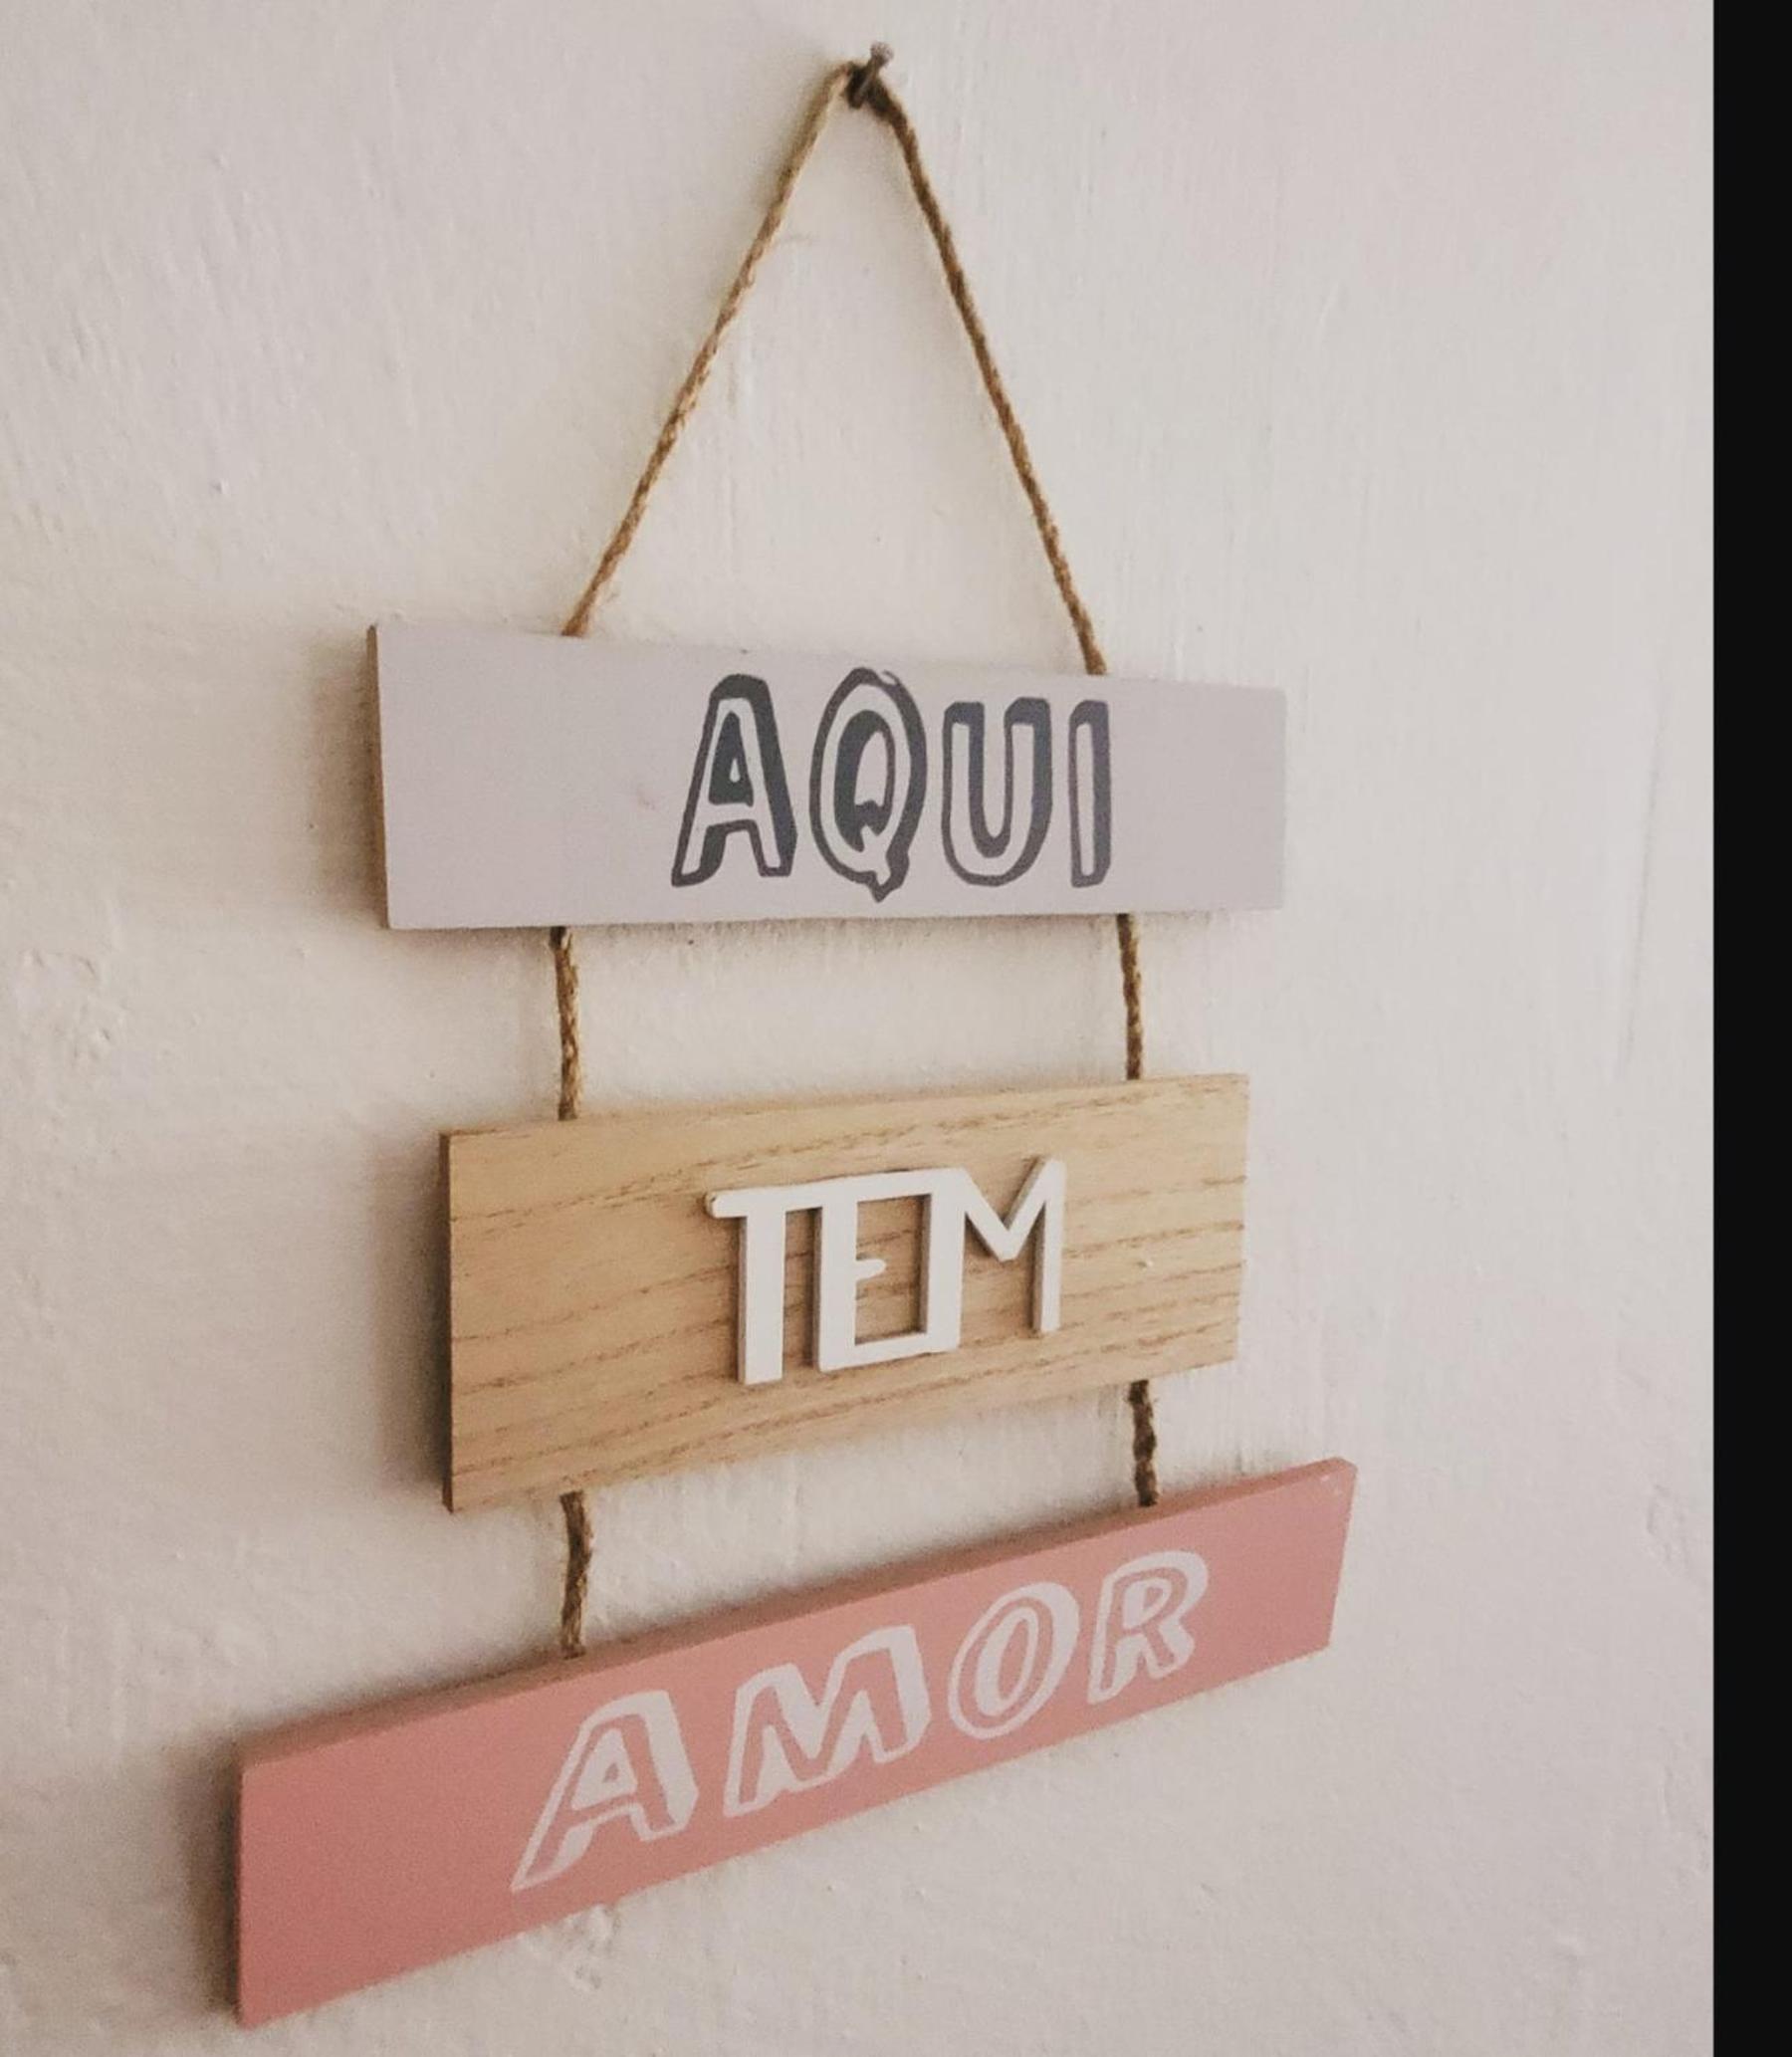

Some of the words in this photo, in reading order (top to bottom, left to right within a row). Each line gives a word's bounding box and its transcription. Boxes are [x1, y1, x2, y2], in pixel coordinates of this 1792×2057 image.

[671, 666, 1112, 903] AQUI
[705, 1156, 1067, 1386] TEM
[510, 1550, 1209, 1893] AMOR
